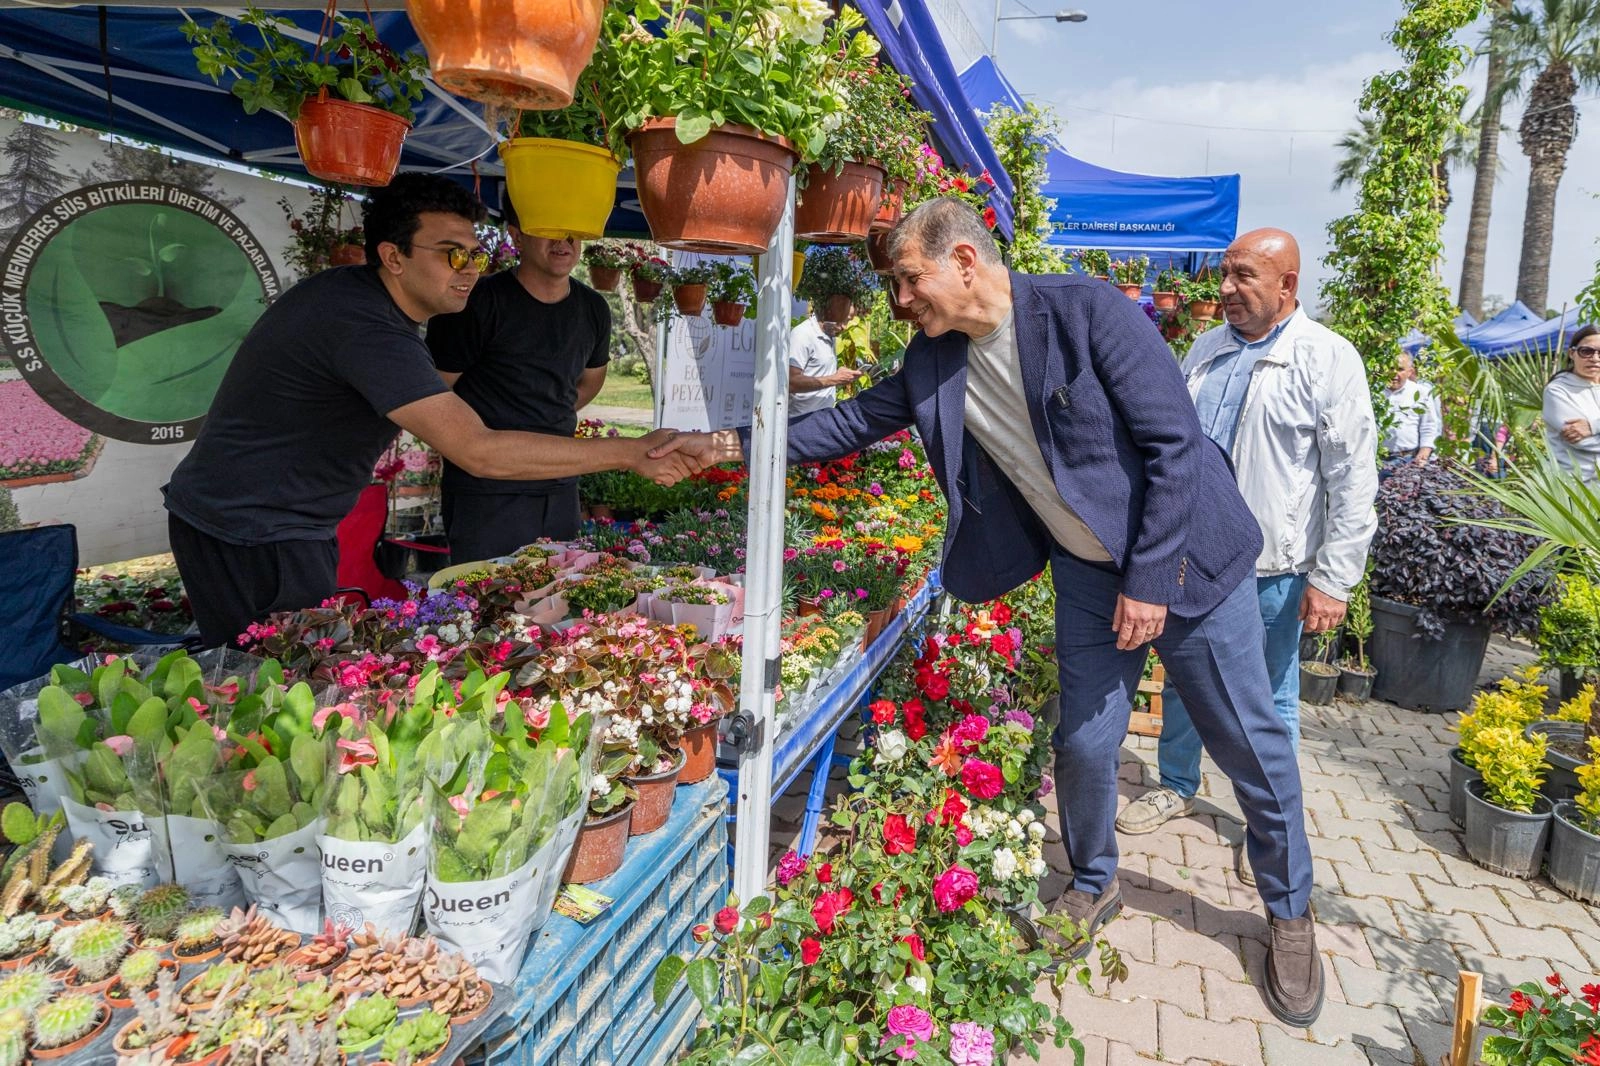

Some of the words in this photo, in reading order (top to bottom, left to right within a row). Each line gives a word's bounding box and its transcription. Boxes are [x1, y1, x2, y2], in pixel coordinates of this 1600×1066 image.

[87, 183, 165, 207] BİTKİLERİ
[168, 187, 220, 220] ÜRETİM
[53, 197, 87, 221] SÜS
[218, 213, 236, 232] VE
[1081, 221, 1118, 231] DAİRESİ
[1119, 222, 1175, 233] BAŞKANLIĞI
[3, 214, 59, 289] MENDERES
[231, 227, 278, 298] PAZARLAMA
[0, 291, 29, 345] KÜÇÜK
[151, 425, 184, 440] 2015
